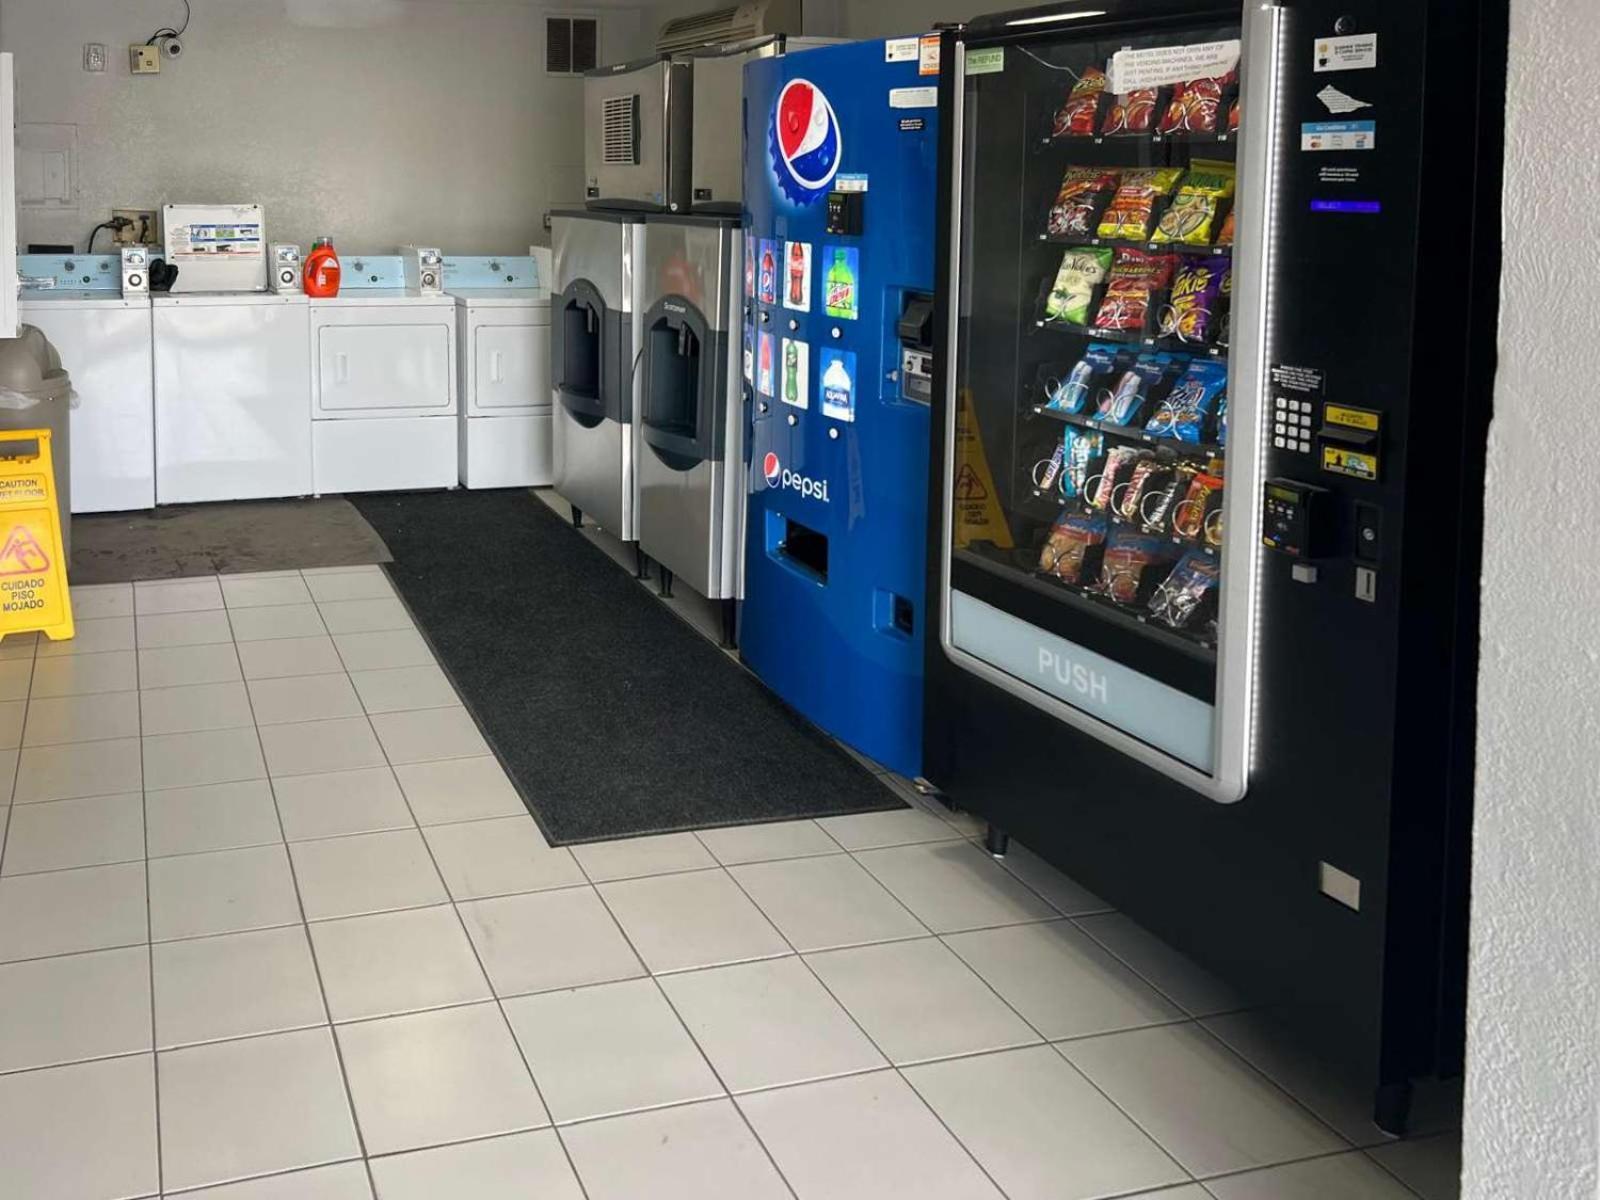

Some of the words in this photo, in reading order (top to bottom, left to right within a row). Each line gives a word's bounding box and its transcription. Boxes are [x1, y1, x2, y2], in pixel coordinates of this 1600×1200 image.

[0, 479, 37, 489] CAUTION
[782, 468, 830, 503] pepsi
[1, 578, 45, 591] CUIDADO
[11, 589, 35, 601] PISO
[3, 599, 44, 612] MOJADO
[1038, 646, 1107, 705] PUSH
